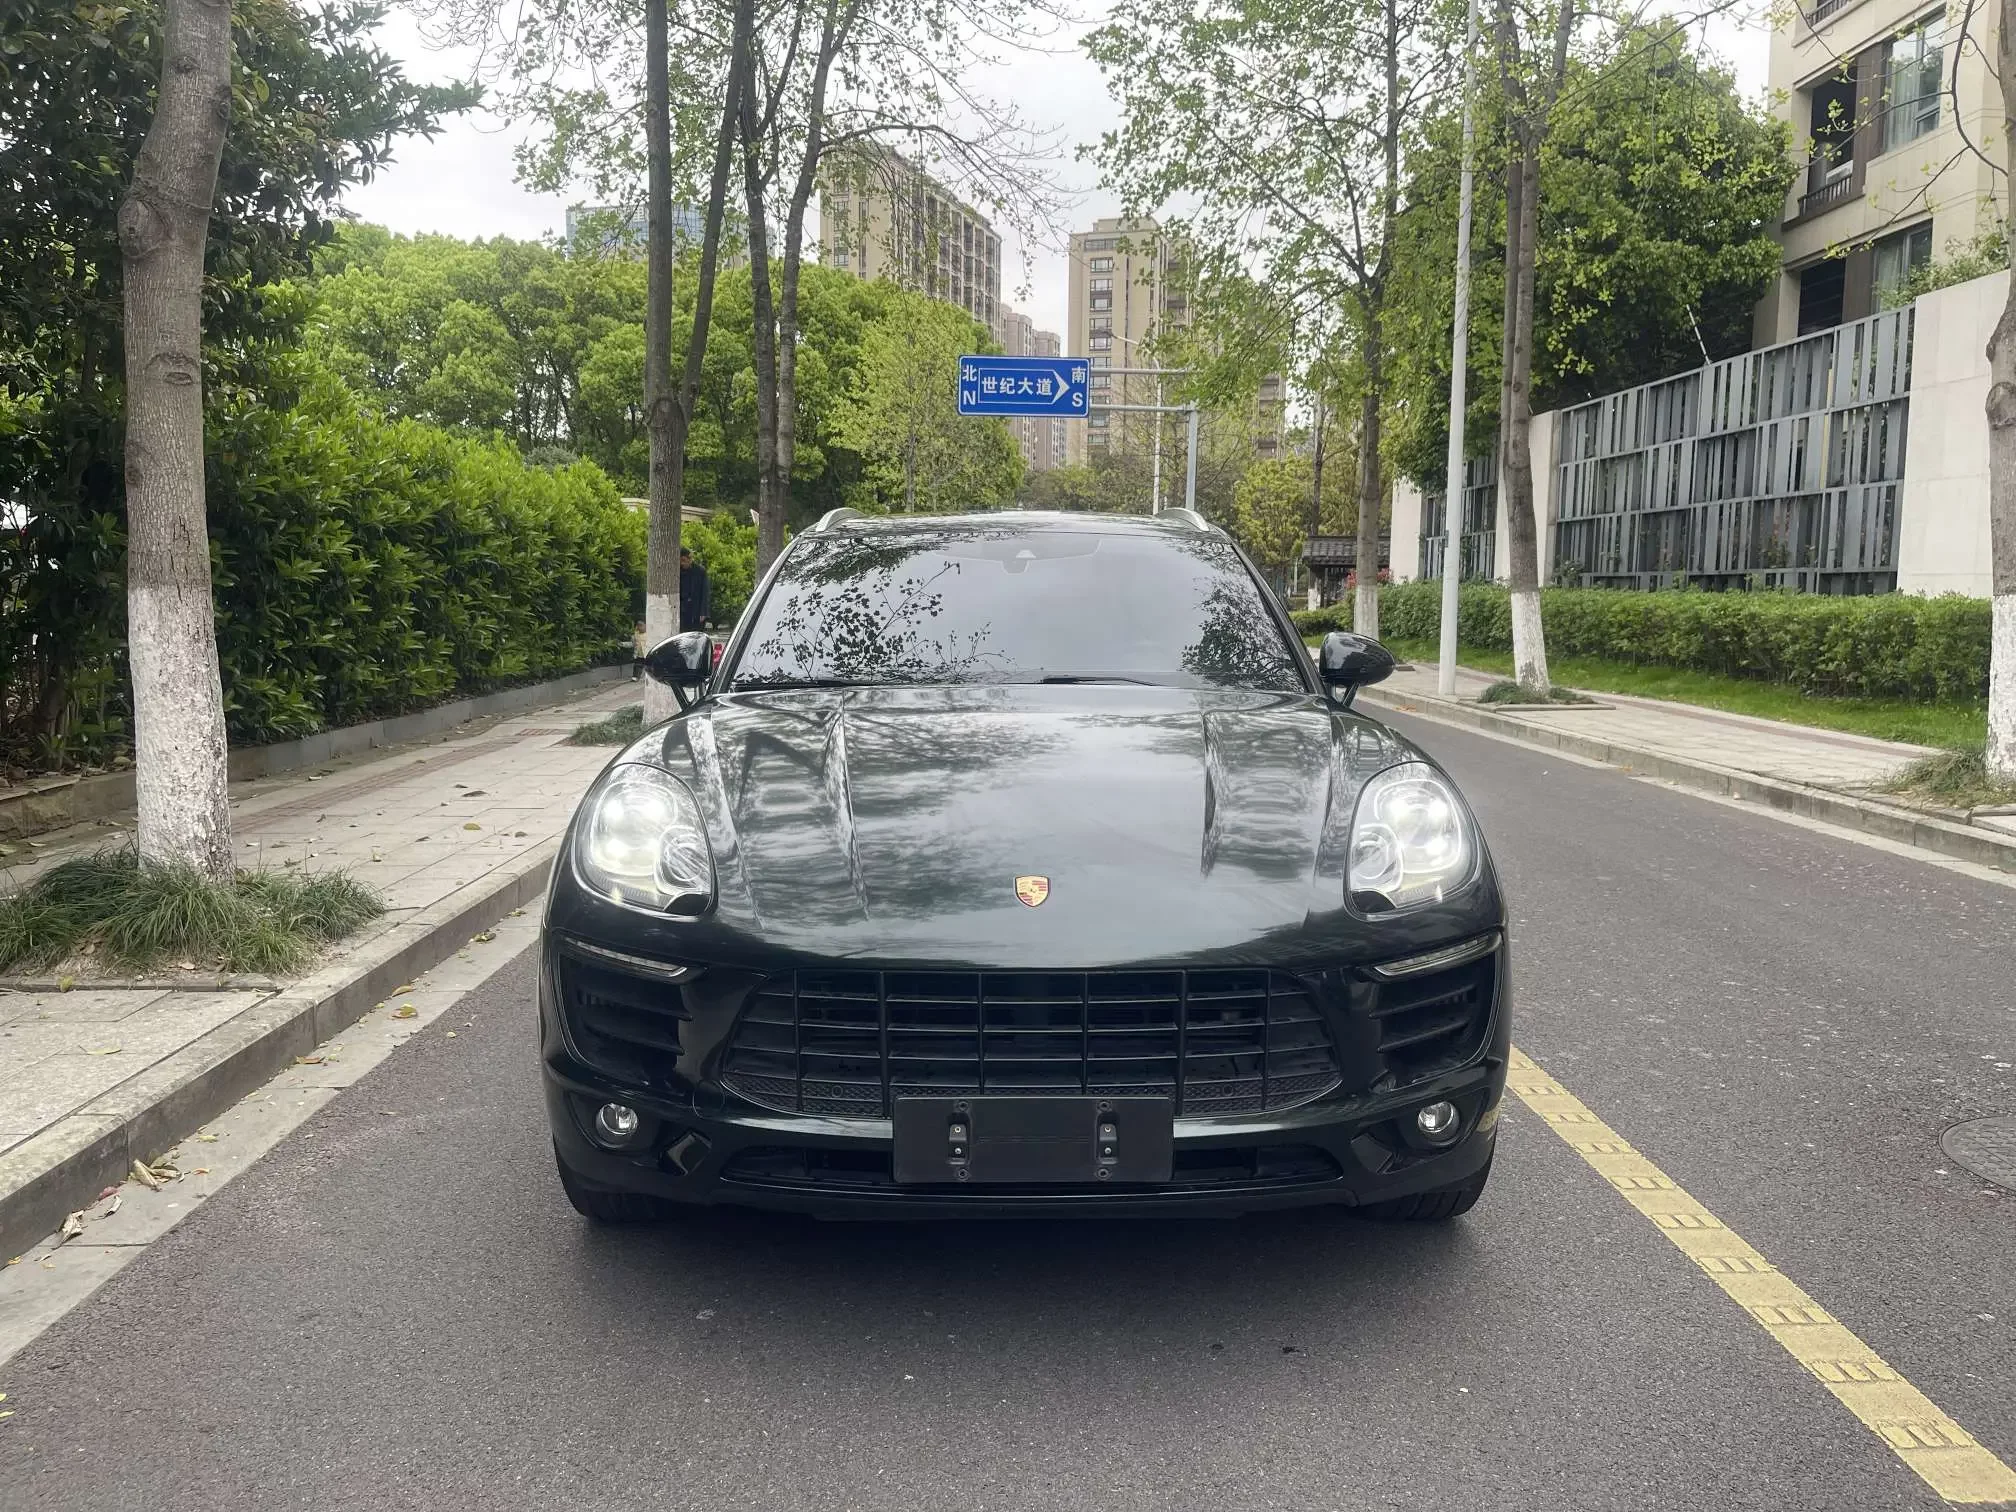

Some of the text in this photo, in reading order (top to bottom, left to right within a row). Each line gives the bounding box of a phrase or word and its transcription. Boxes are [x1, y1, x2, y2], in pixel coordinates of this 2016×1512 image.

[962, 364, 977, 382] 北
[1072, 366, 1086, 384] 南
[982, 376, 1052, 396] 世纪大道
[962, 391, 976, 406] N
[1072, 392, 1084, 408] S
